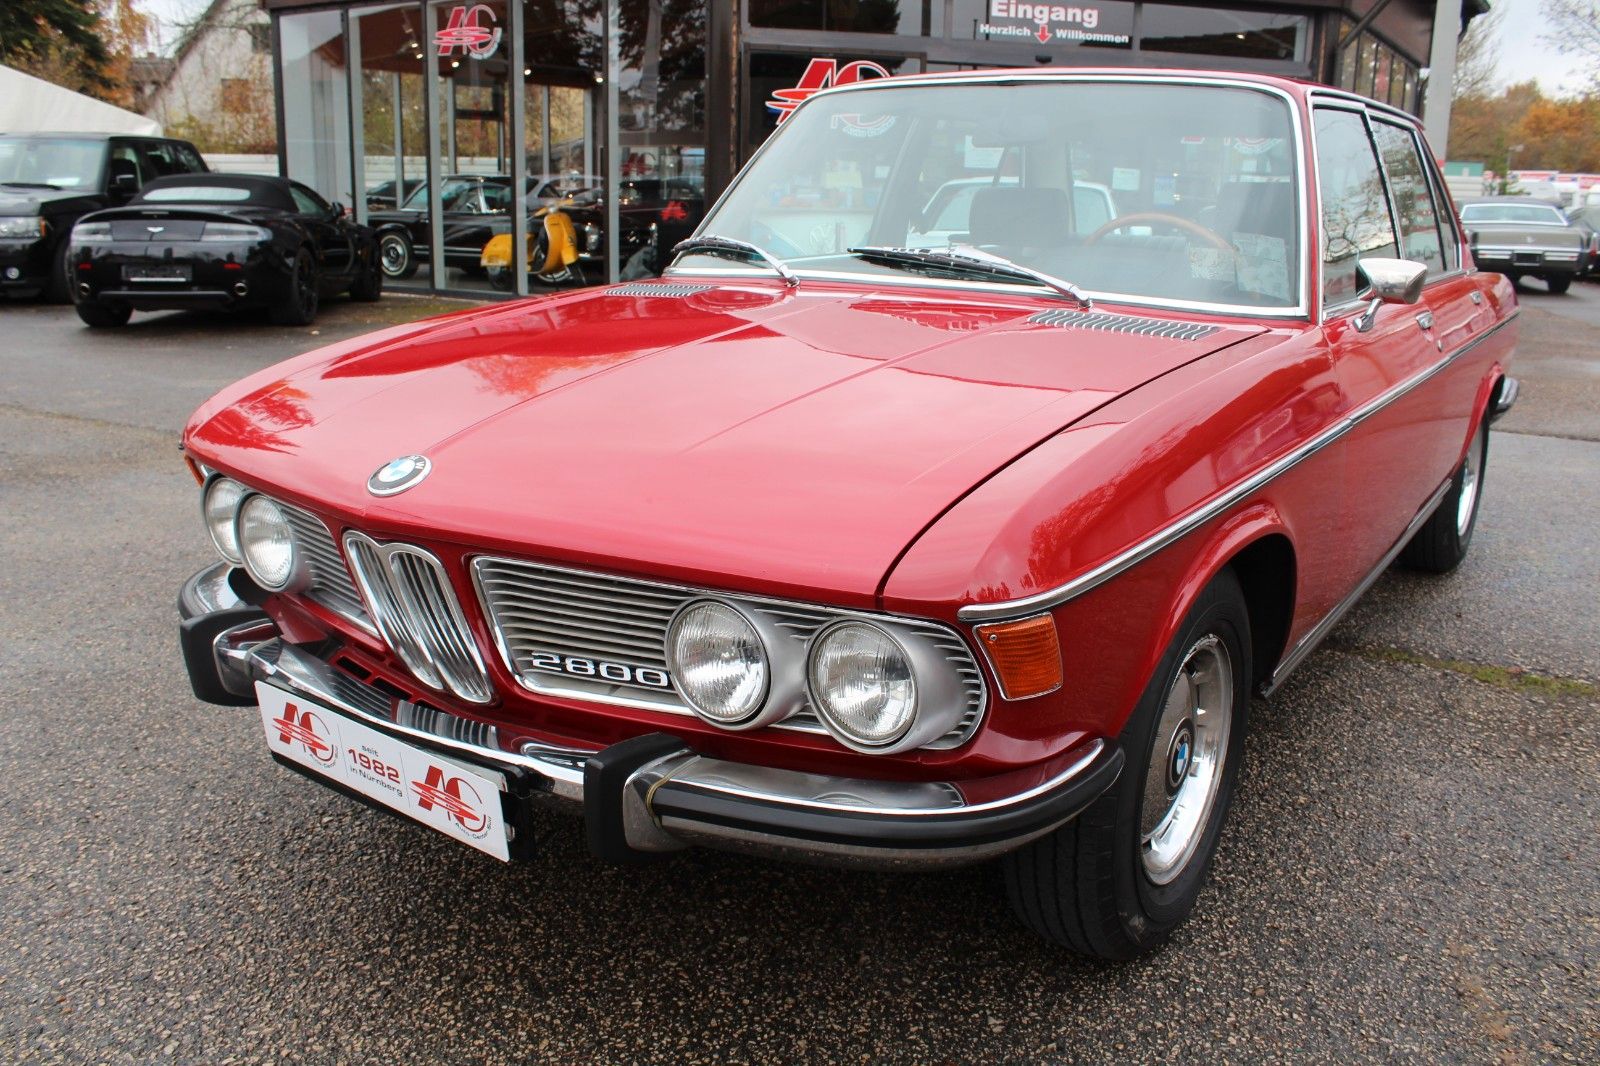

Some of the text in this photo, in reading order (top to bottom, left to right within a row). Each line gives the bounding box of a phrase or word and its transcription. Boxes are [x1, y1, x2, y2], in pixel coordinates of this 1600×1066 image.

[991, 0, 1099, 28] Eingang
[979, 23, 1129, 43] Herzlich Willkommen
[531, 651, 669, 687] 2800
[348, 748, 400, 784] 1982
